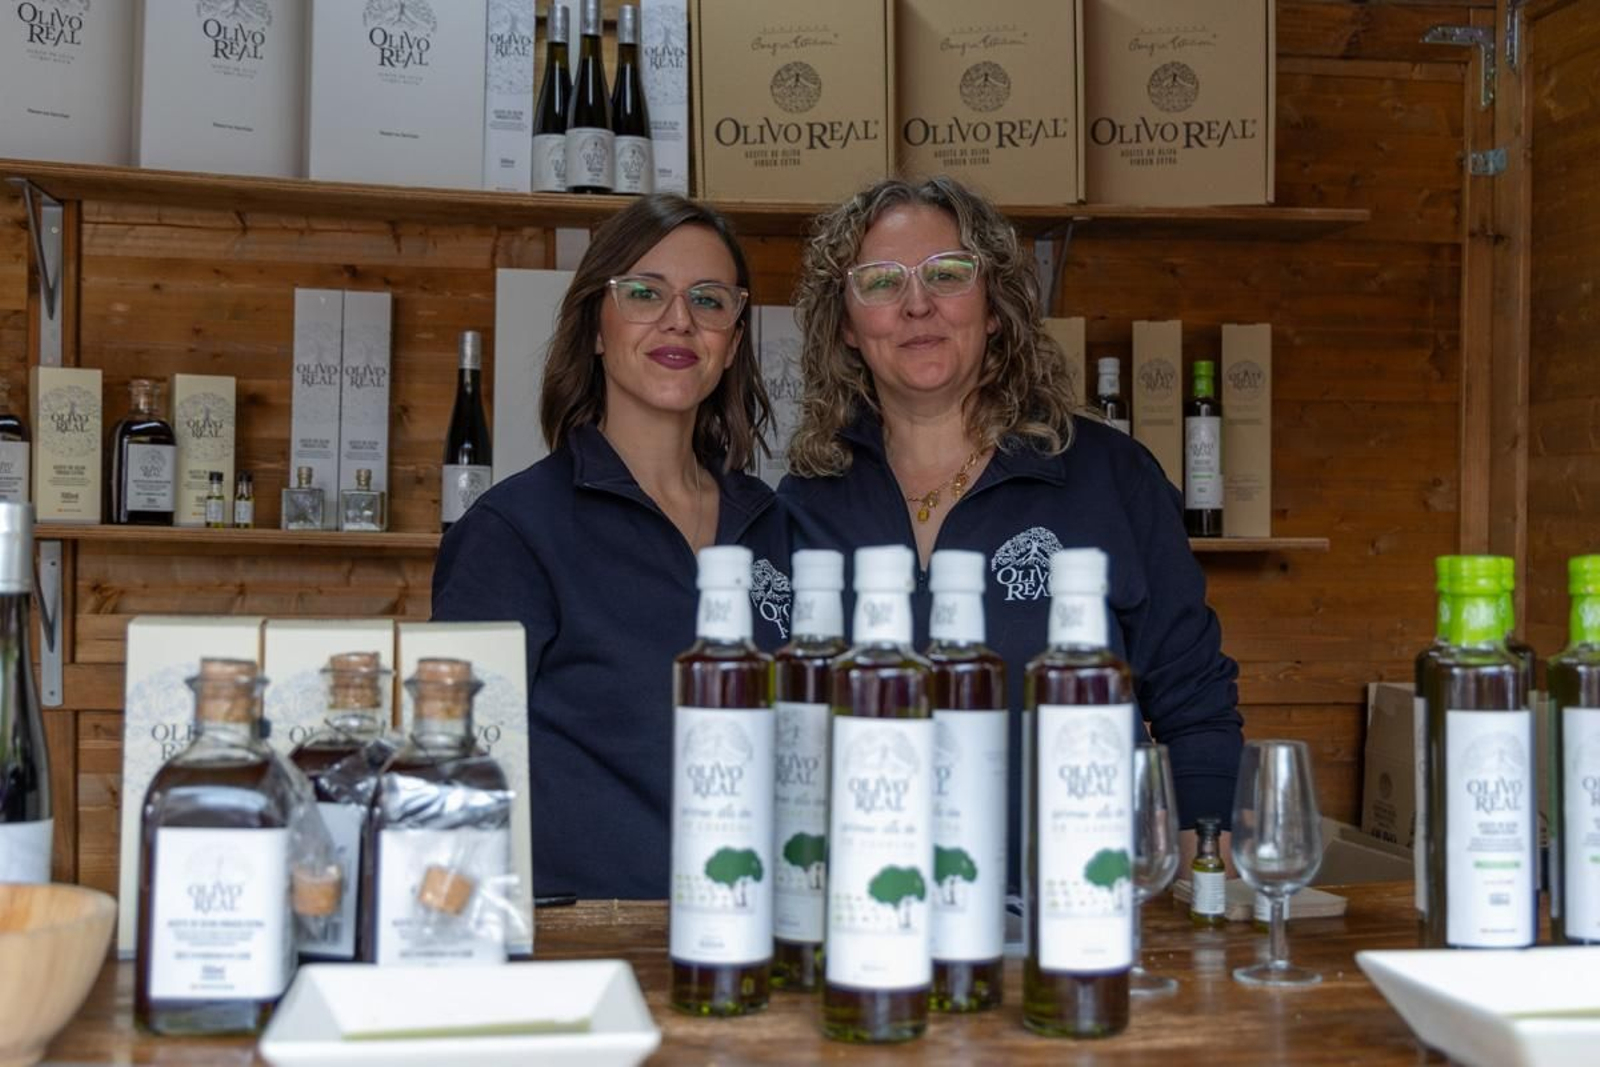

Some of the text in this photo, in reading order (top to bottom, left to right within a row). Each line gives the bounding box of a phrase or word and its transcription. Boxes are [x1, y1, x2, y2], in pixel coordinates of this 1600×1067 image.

[17, 2, 83, 31] OLIVO
[27, 23, 81, 46] REAL
[203, 18, 265, 45] OLIVO
[369, 27, 430, 52] OLIVO
[490, 32, 531, 48] OLIVO
[213, 40, 263, 61] REAL
[378, 48, 429, 68] REAL
[495, 45, 530, 57] REAL
[715, 117, 802, 146] OLIVO
[806, 120, 877, 150] REAL
[904, 117, 1067, 148] OLIVO REAL
[1090, 117, 1255, 148] OLIVO REAL
[296, 361, 338, 376] OLIVO
[345, 363, 386, 378] OLIVO
[301, 373, 337, 387] REAL
[350, 376, 384, 389] REAL
[1004, 583, 1054, 600] REA
[686, 761, 744, 780] OLIVO
[1058, 761, 1118, 781] OLIVO
[692, 779, 741, 799] REAL
[847, 774, 909, 794] OLIVO
[1067, 779, 1116, 801] REAL
[1466, 776, 1523, 797] OLIVO
[855, 792, 906, 816] REAL
[1476, 796, 1521, 816] REAL
